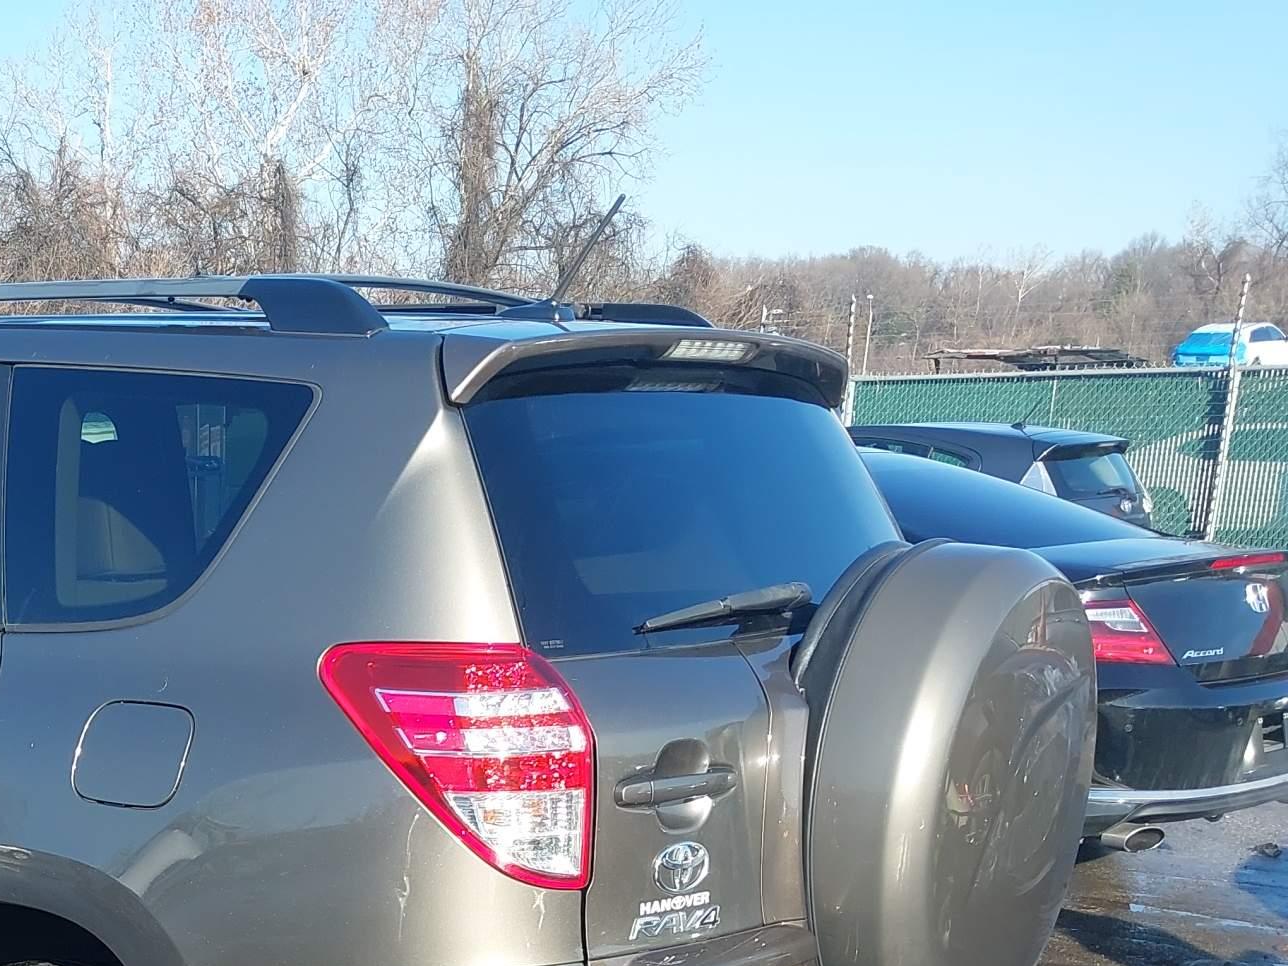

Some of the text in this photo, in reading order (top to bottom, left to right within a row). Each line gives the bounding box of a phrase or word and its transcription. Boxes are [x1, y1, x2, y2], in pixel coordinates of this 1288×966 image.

[1182, 647, 1224, 659] Accord
[639, 891, 710, 916] HANOVER
[629, 905, 721, 940] RAV4
